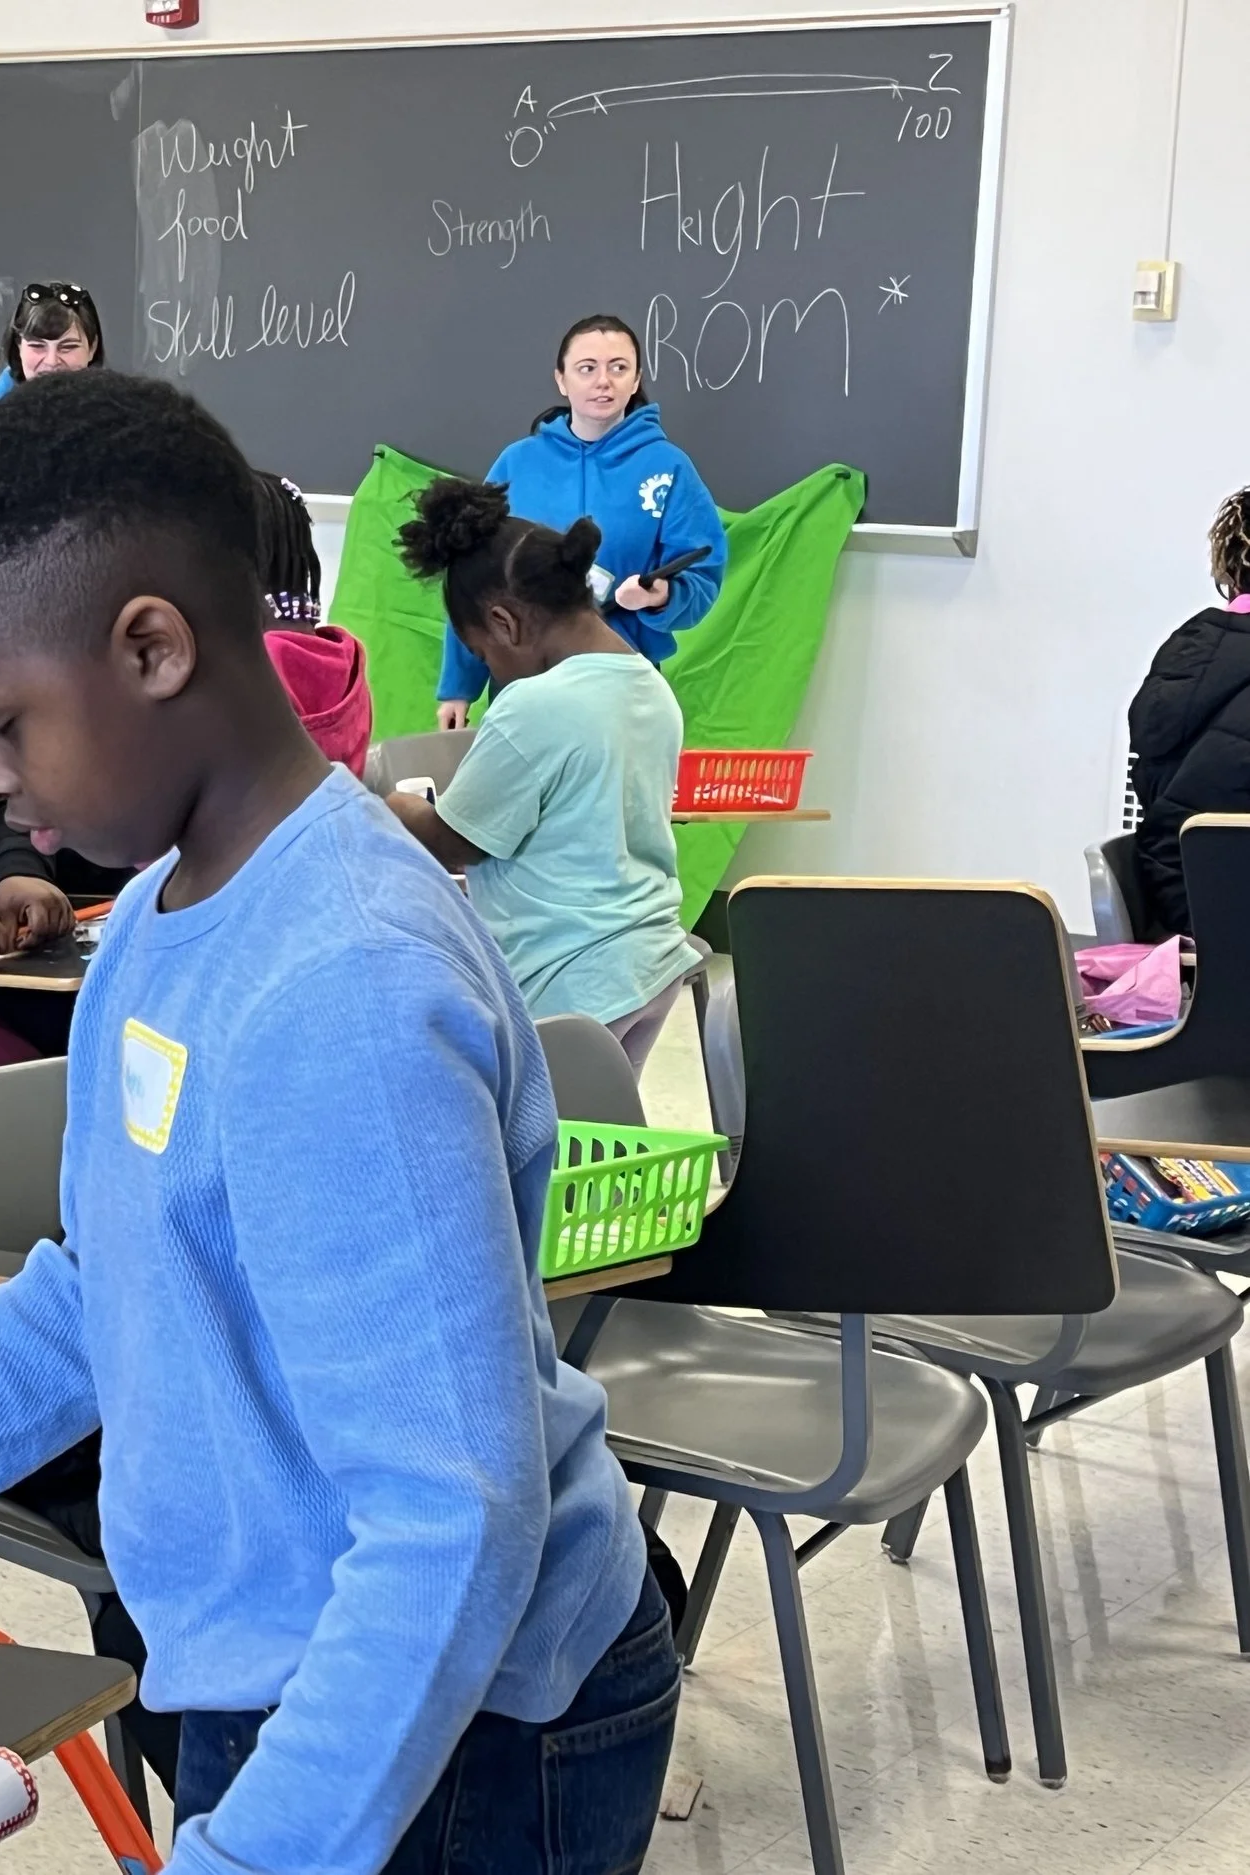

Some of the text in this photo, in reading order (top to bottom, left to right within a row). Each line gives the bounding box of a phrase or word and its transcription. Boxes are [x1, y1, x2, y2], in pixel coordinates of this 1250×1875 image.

[513, 84, 538, 118] A
[898, 106, 952, 142] 100
[158, 188, 248, 282] food
[427, 199, 551, 269] Strength
[640, 141, 866, 299] Height
[246, 270, 356, 352] level
[645, 287, 850, 397] ROM
